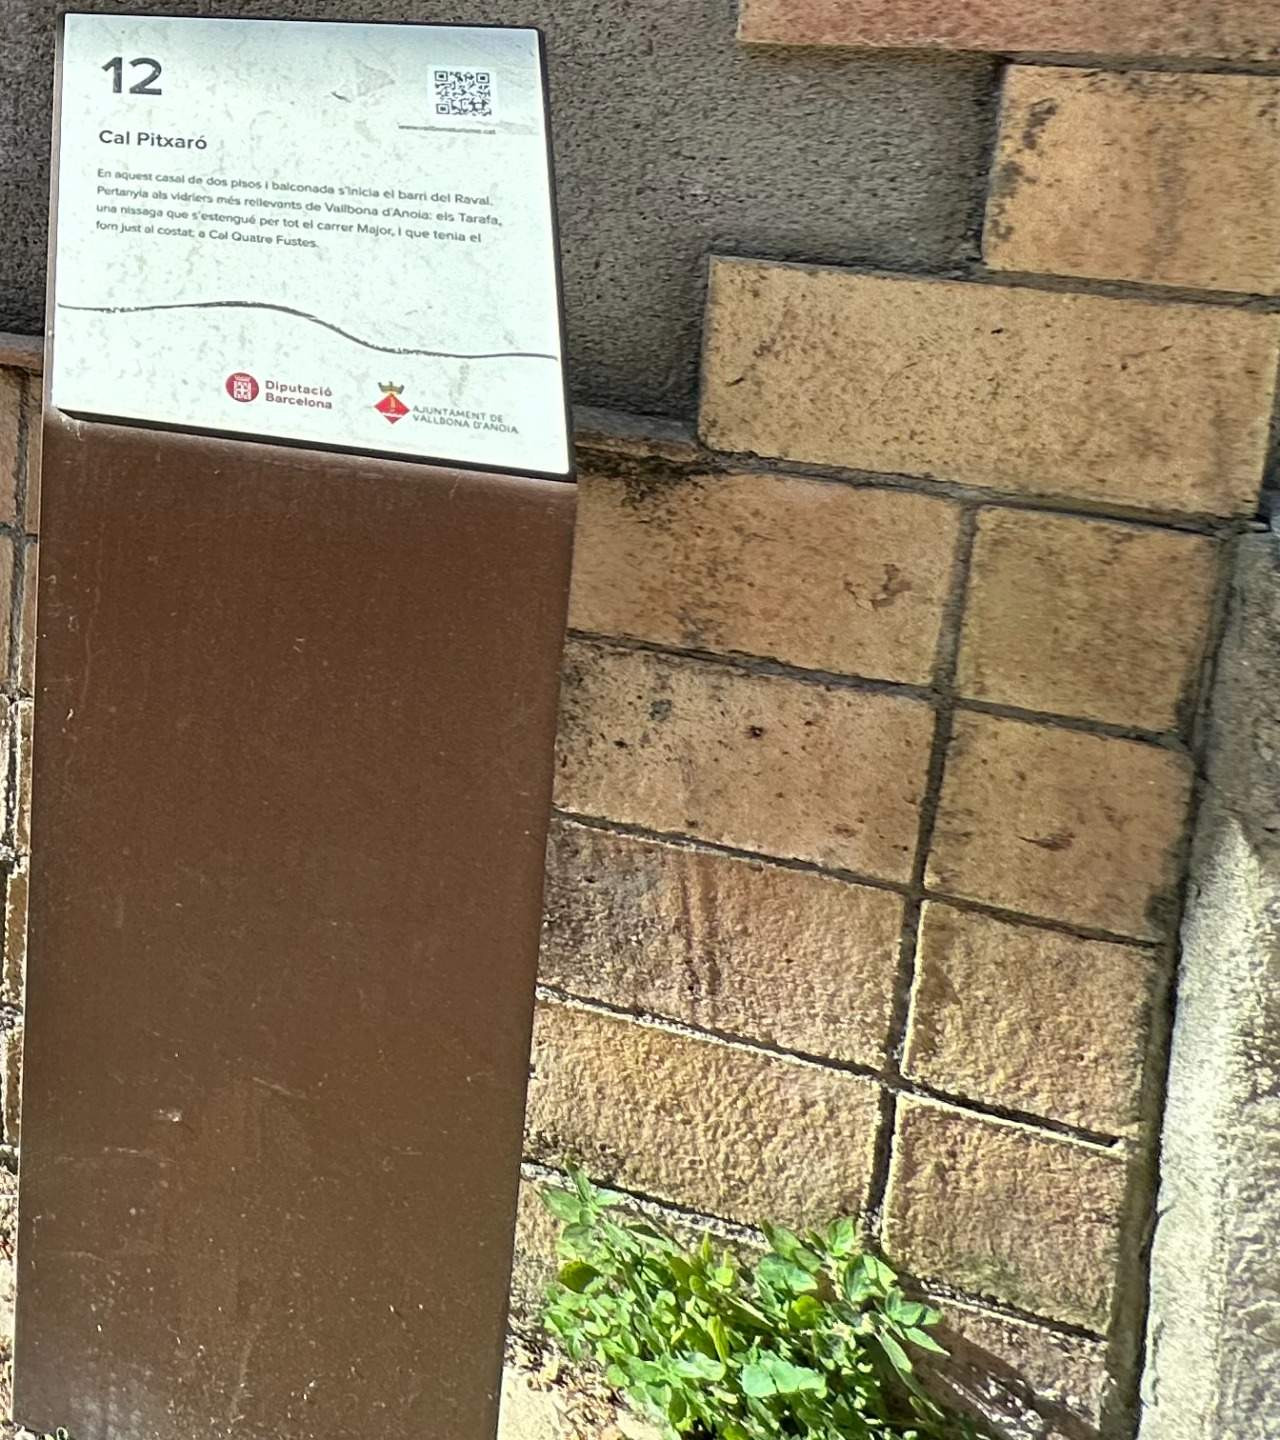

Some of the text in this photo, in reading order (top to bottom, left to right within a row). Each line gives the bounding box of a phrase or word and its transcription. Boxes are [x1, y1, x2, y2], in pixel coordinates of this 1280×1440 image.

[101, 56, 162, 96] 12
[99, 129, 207, 150] Cal Pitxaró
[97, 168, 111, 178] En
[115, 171, 152, 181] aquest
[155, 174, 185, 183] casal
[188, 176, 203, 184] de
[206, 177, 228, 186] dos
[231, 179, 262, 189] pisos
[271, 181, 335, 194] balconada
[383, 190, 395, 199] el
[398, 190, 427, 201] barri
[430, 192, 451, 203] del
[454, 193, 493, 206] Raval.
[152, 190, 168, 200] als
[170, 192, 213, 203] vidriers
[216, 195, 241, 206] més
[244, 198, 302, 210] rellevants
[305, 202, 321, 211] de
[324, 202, 378, 216] Vallbona
[436, 211, 455, 222] els
[96, 205, 117, 213] una
[120, 206, 163, 218] nissaga
[166, 210, 189, 220] que
[259, 217, 280, 227] per
[283, 218, 299, 228] tot
[302, 219, 314, 229] el
[317, 222, 354, 233] carrer
[405, 229, 430, 239] que
[433, 230, 466, 242] tenia
[470, 233, 482, 243] el
[96, 220, 118, 230] forn
[120, 223, 141, 233] just
[144, 224, 154, 234] al
[198, 230, 206, 239] a
[209, 229, 228, 240] Cal
[231, 231, 273, 244] Quatre
[265, 380, 333, 397] Diputació
[265, 392, 333, 409] Barcelona
[413, 405, 504, 423] AJUNTAMENT DE
[413, 414, 520, 434] VALLBONA D'ANOIA
